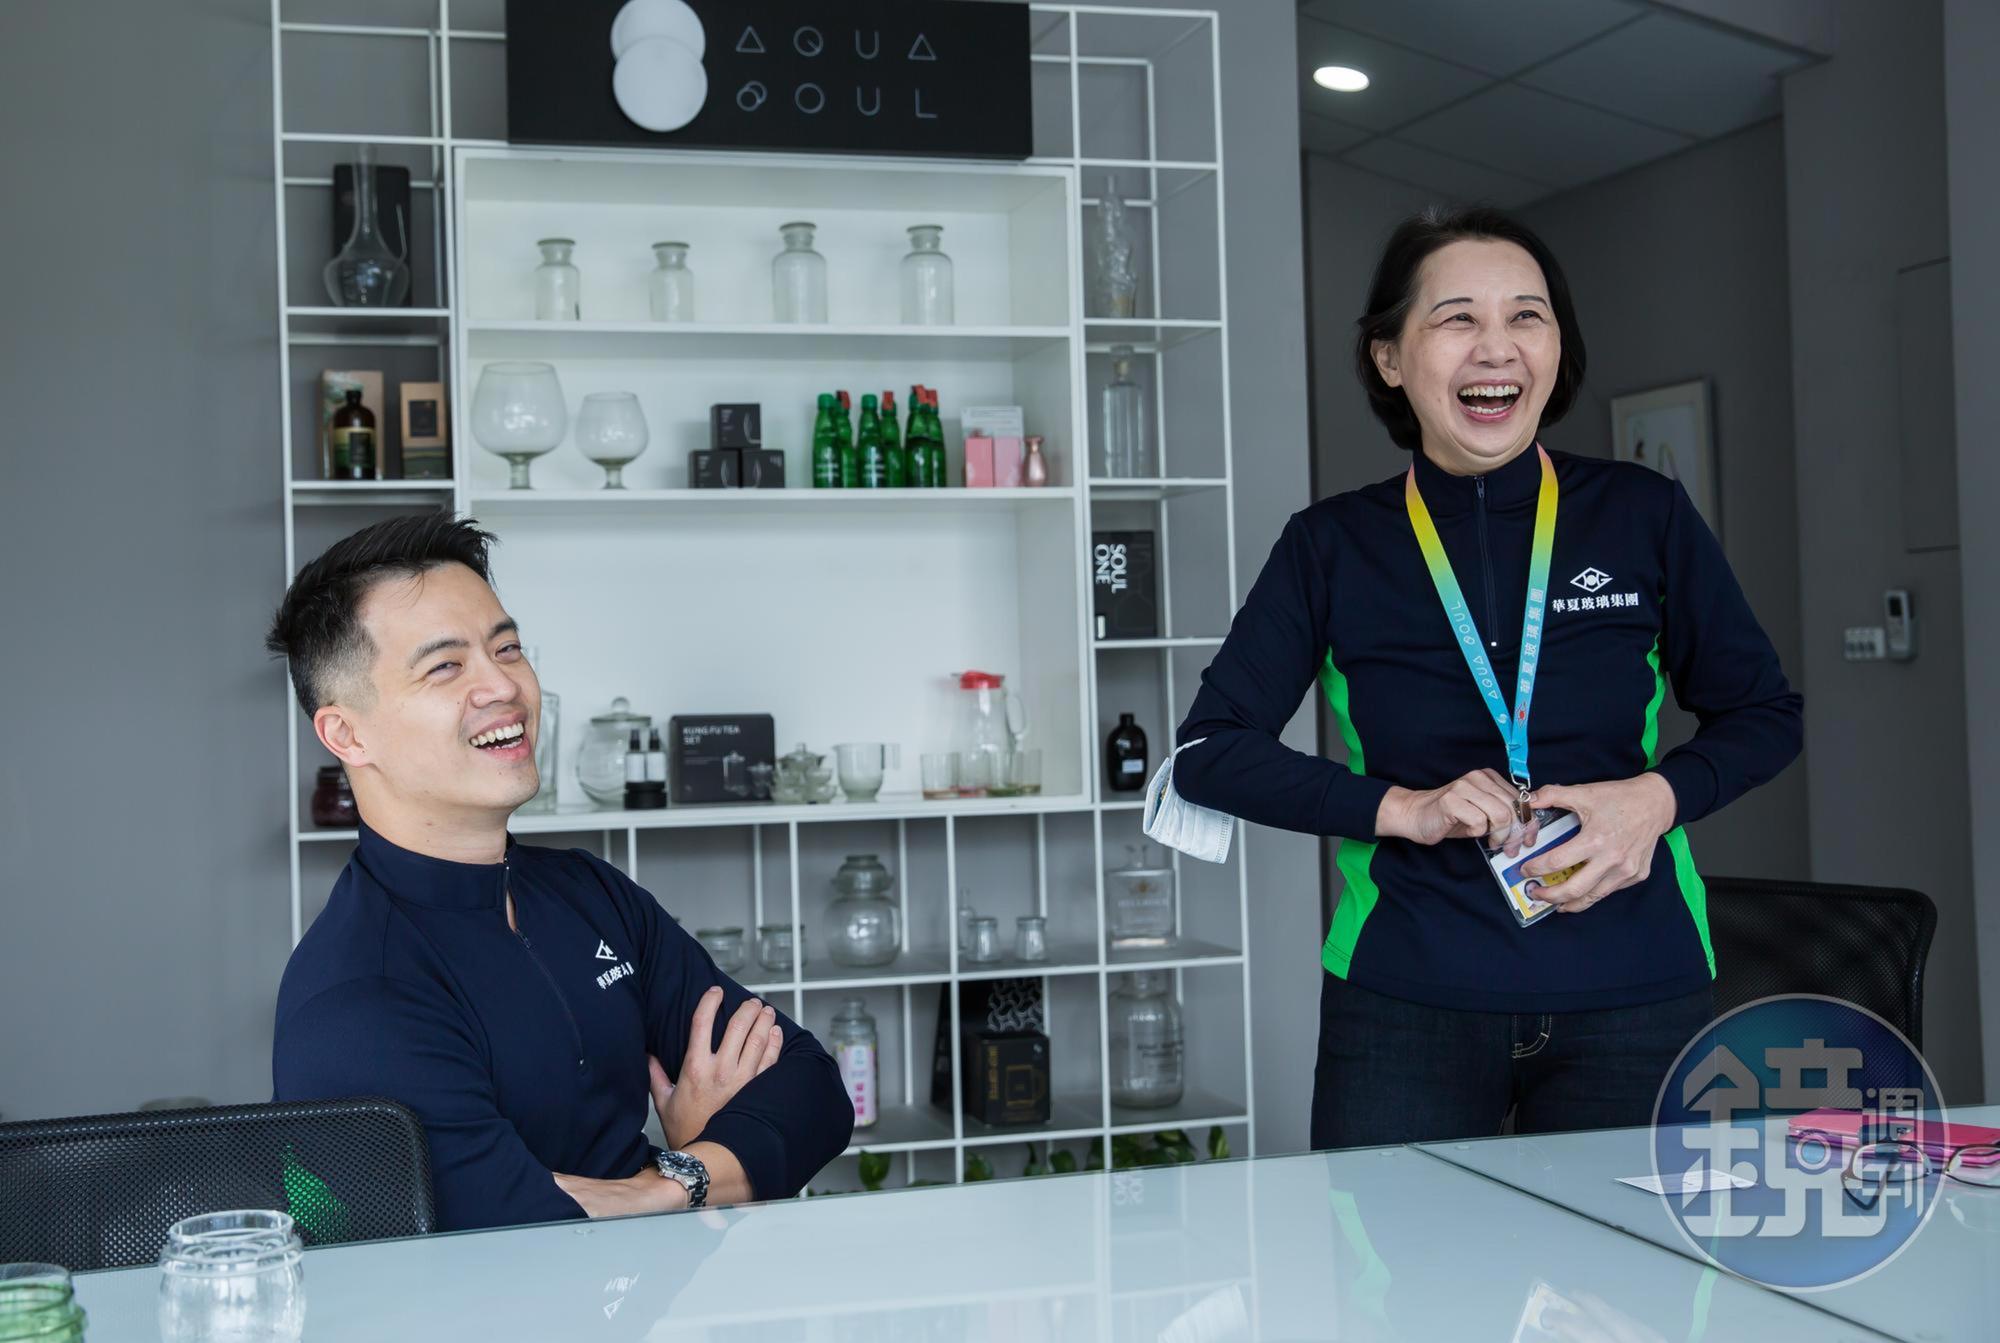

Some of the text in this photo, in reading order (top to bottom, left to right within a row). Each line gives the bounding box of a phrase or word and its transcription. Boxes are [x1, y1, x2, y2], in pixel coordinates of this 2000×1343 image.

[735, 25, 938, 61] AQUA
[1094, 543, 1111, 585] ONE
[1109, 543, 1128, 594] SOUL
[1551, 592, 1640, 613] 華夏玻璃集團
[683, 736, 701, 746] SET
